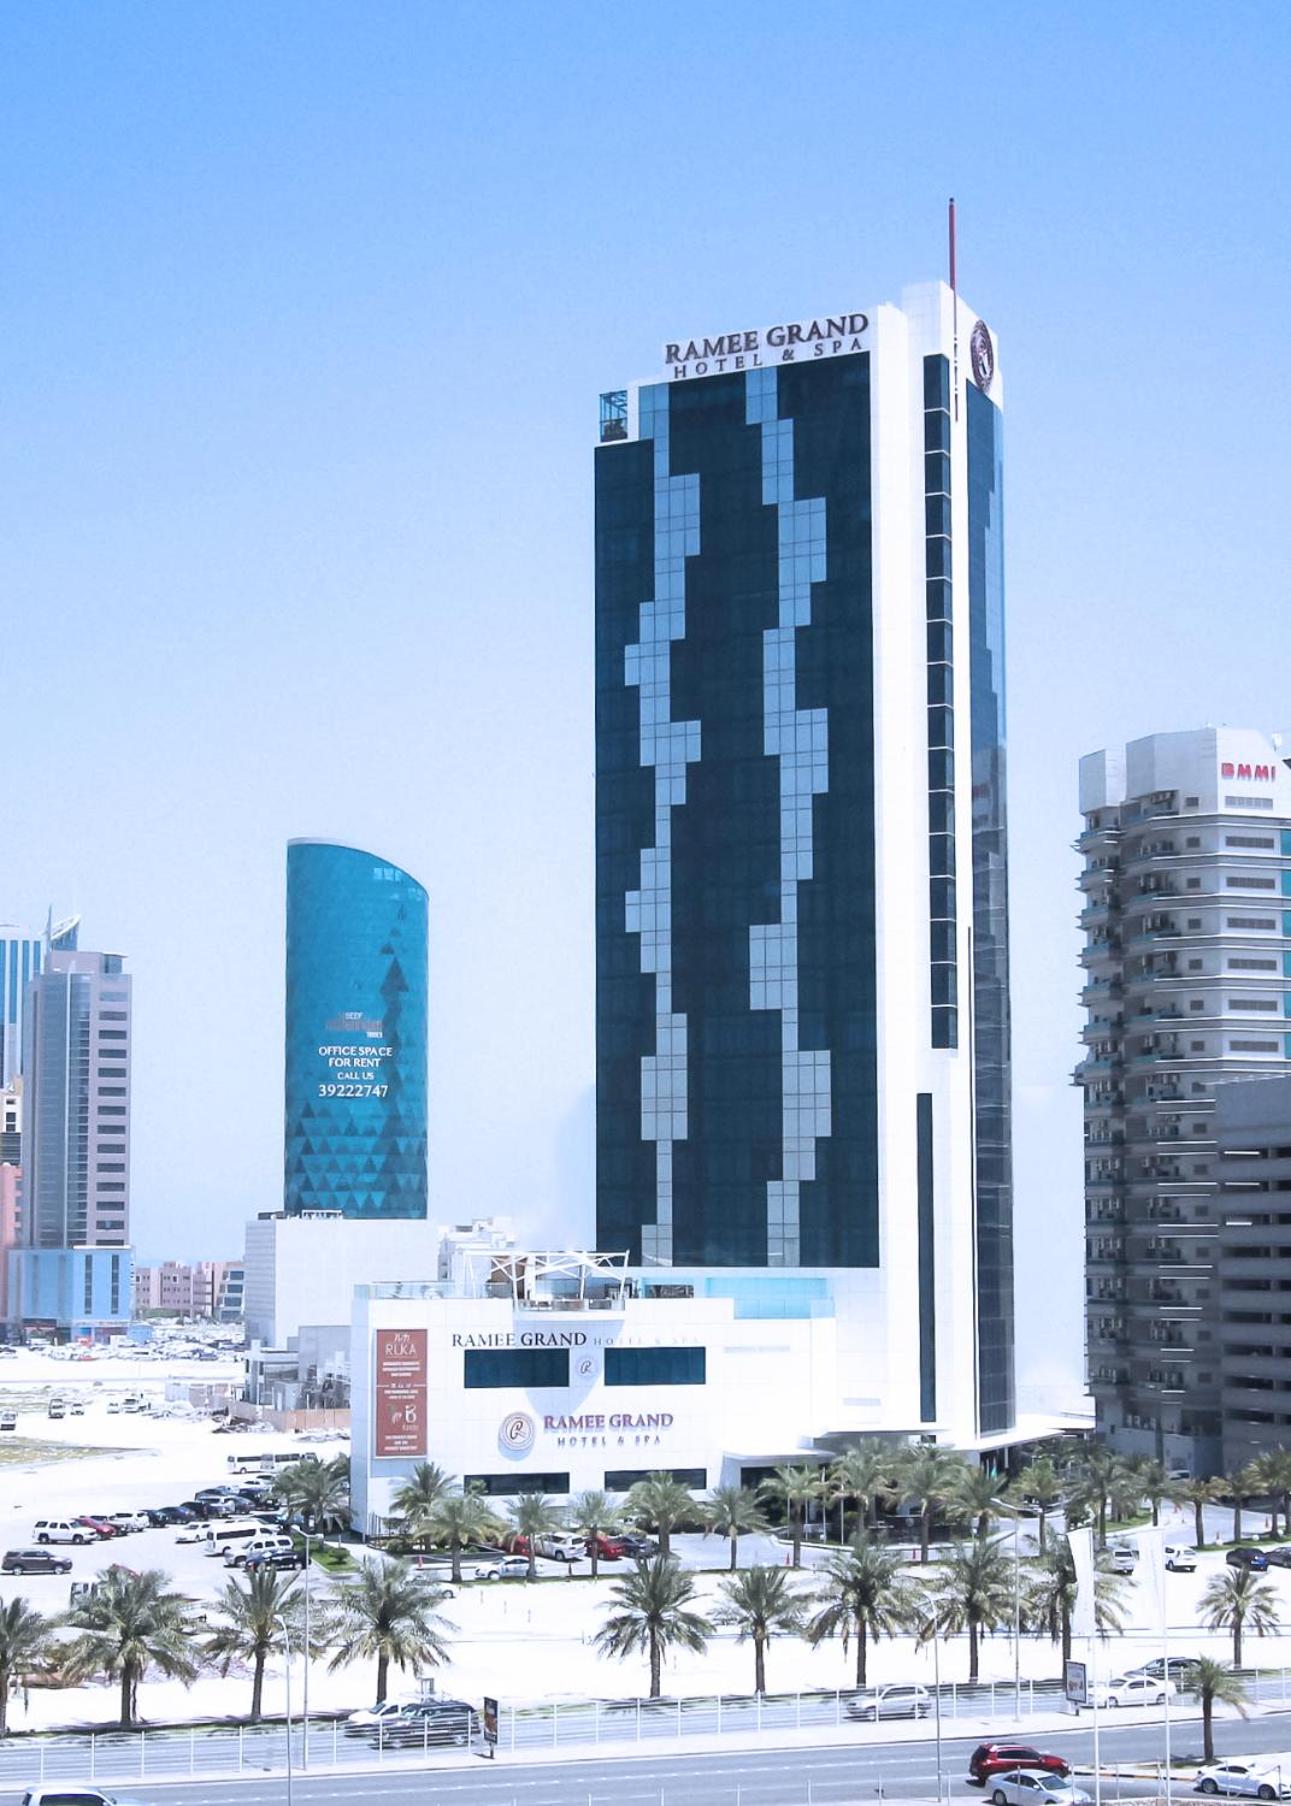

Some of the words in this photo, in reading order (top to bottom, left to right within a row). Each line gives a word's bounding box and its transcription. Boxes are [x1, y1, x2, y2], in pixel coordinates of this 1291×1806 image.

[665, 330, 760, 365] RAMEE
[766, 313, 869, 348] GRAND
[674, 354, 763, 380] HOTEL
[782, 348, 795, 361] &
[814, 337, 863, 357] SPA
[318, 1046, 357, 1057] OFFICE
[358, 1047, 393, 1057] SPACE
[328, 1058, 352, 1068] FOR
[353, 1058, 381, 1068] RENT
[337, 1071, 360, 1080] CALL
[361, 1071, 375, 1080] US
[318, 1083, 389, 1098] 39222747
[452, 1333, 516, 1348] RAMEE
[520, 1331, 587, 1347] GRAND
[543, 1414, 606, 1431] RAMEE
[608, 1412, 675, 1429] GRAND
[557, 1435, 607, 1447] HOTEL
[635, 1434, 661, 1446] SPA
